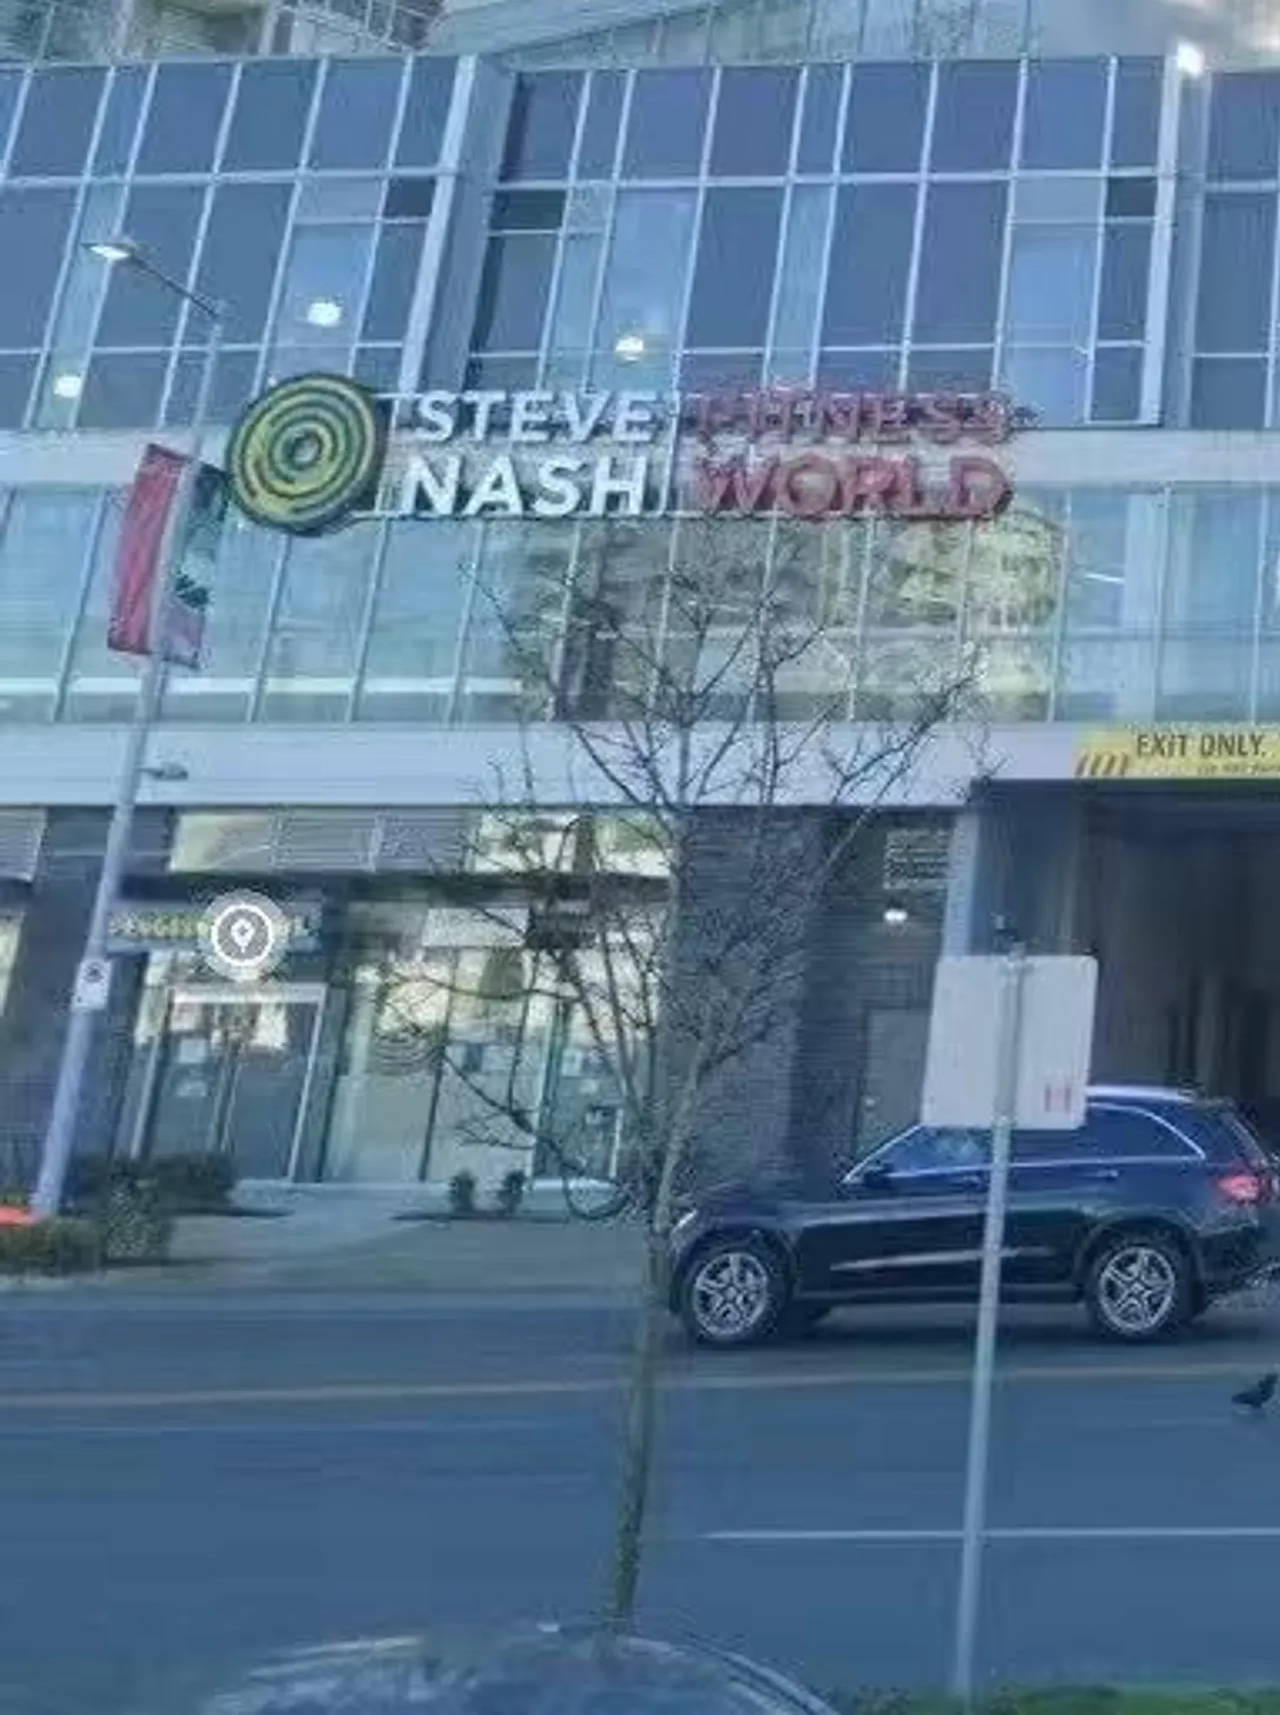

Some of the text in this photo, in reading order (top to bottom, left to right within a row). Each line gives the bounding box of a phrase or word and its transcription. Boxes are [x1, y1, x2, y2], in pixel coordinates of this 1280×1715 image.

[417, 389, 657, 443] STEVE
[400, 454, 648, 518] NASH
[697, 450, 1013, 520] WORLD
[1136, 732, 1187, 758] EXIT
